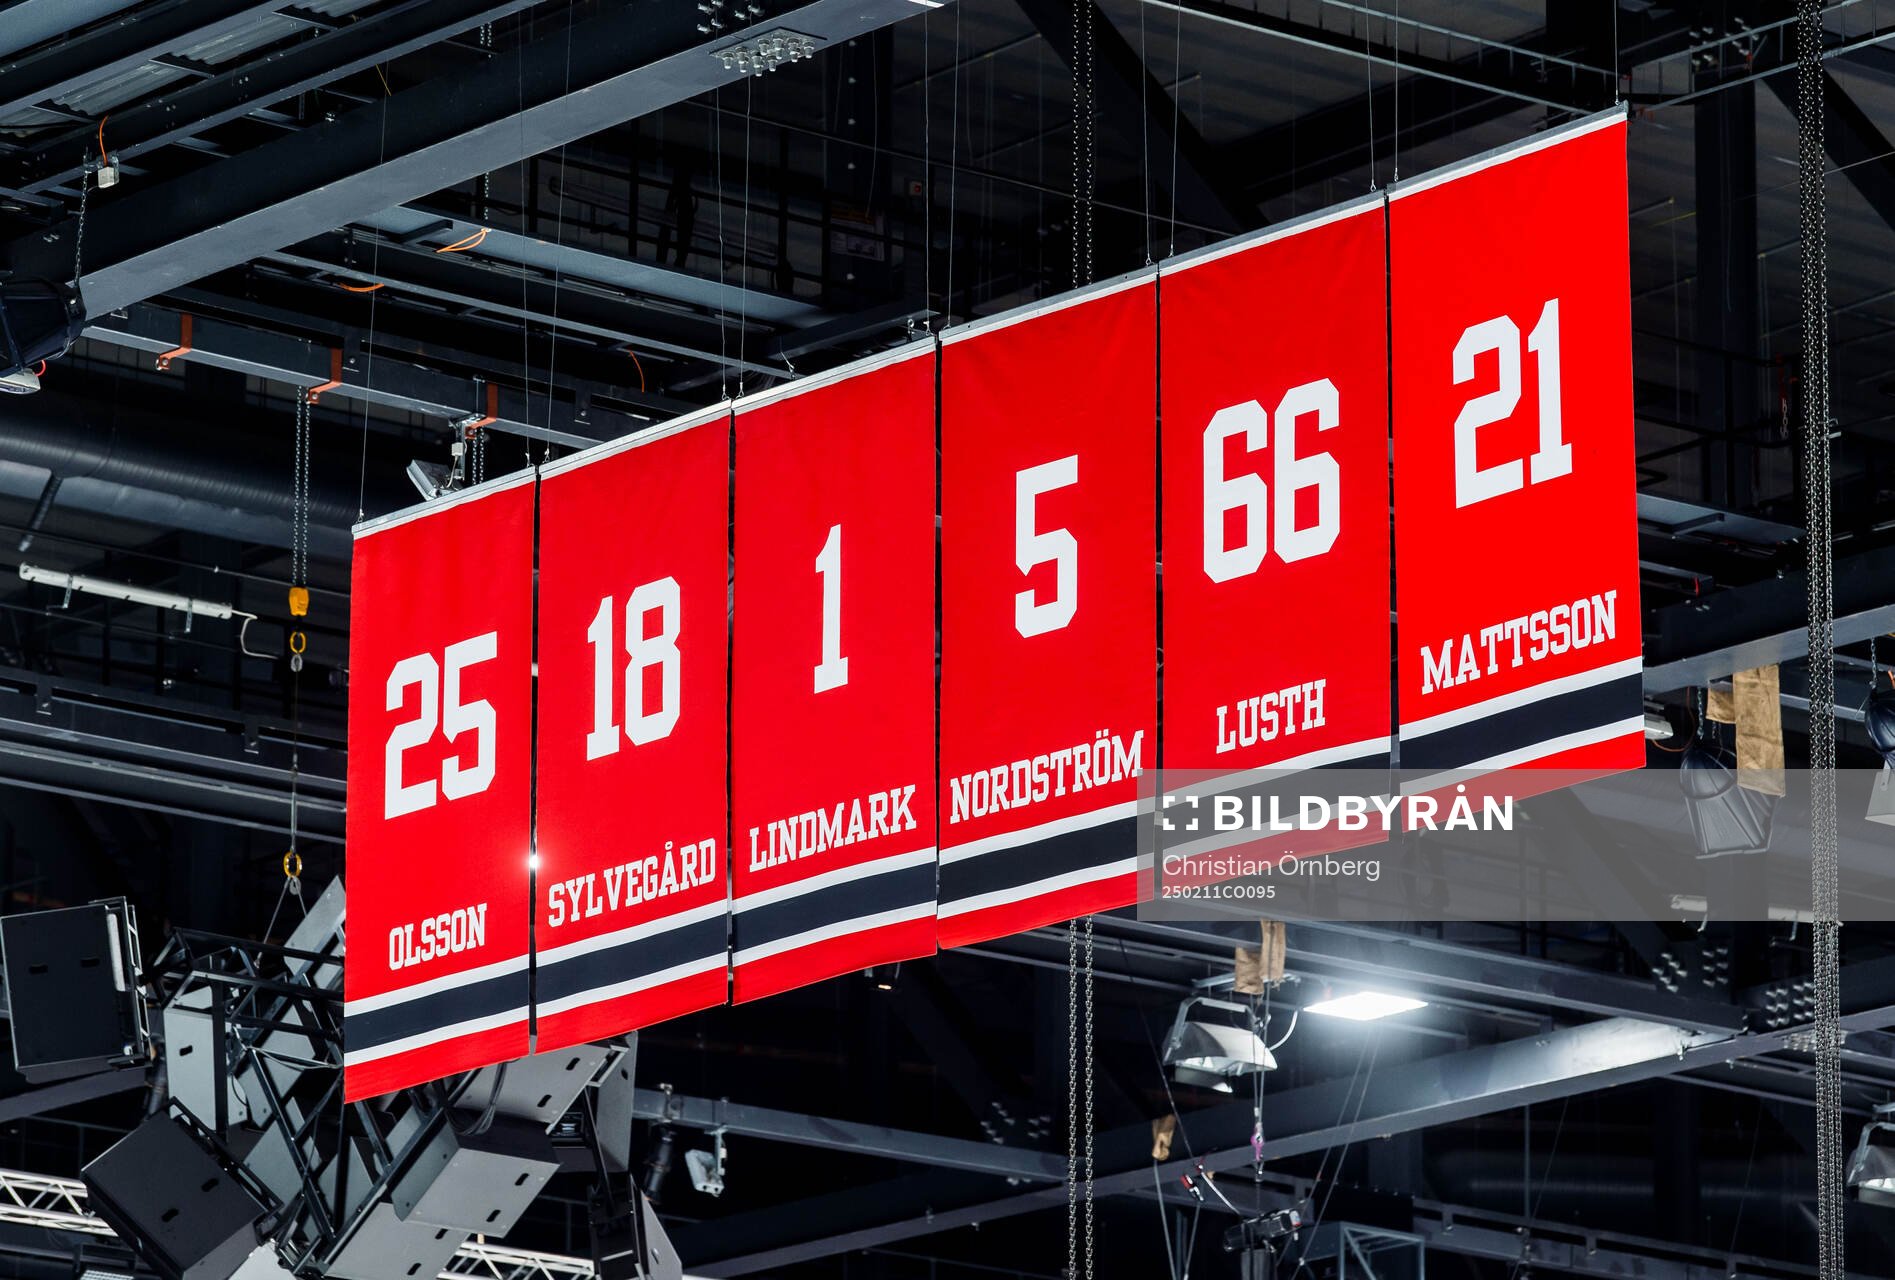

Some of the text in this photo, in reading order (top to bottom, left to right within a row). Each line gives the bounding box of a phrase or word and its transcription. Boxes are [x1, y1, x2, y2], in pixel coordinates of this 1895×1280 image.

[1453, 298, 1572, 508] 21
[1015, 455, 1078, 638] 5
[1204, 378, 1340, 583] 66
[587, 576, 680, 760] 18
[814, 524, 848, 694] 1
[1421, 590, 1617, 695] MATTSSON
[385, 631, 497, 820] 25
[950, 729, 1143, 824] NORDSTRÖM
[1216, 680, 1326, 753] LUSTH
[548, 838, 716, 928] SYLVEGÅRD
[750, 785, 917, 872] LINDMARK
[389, 904, 487, 971] OLSSON
